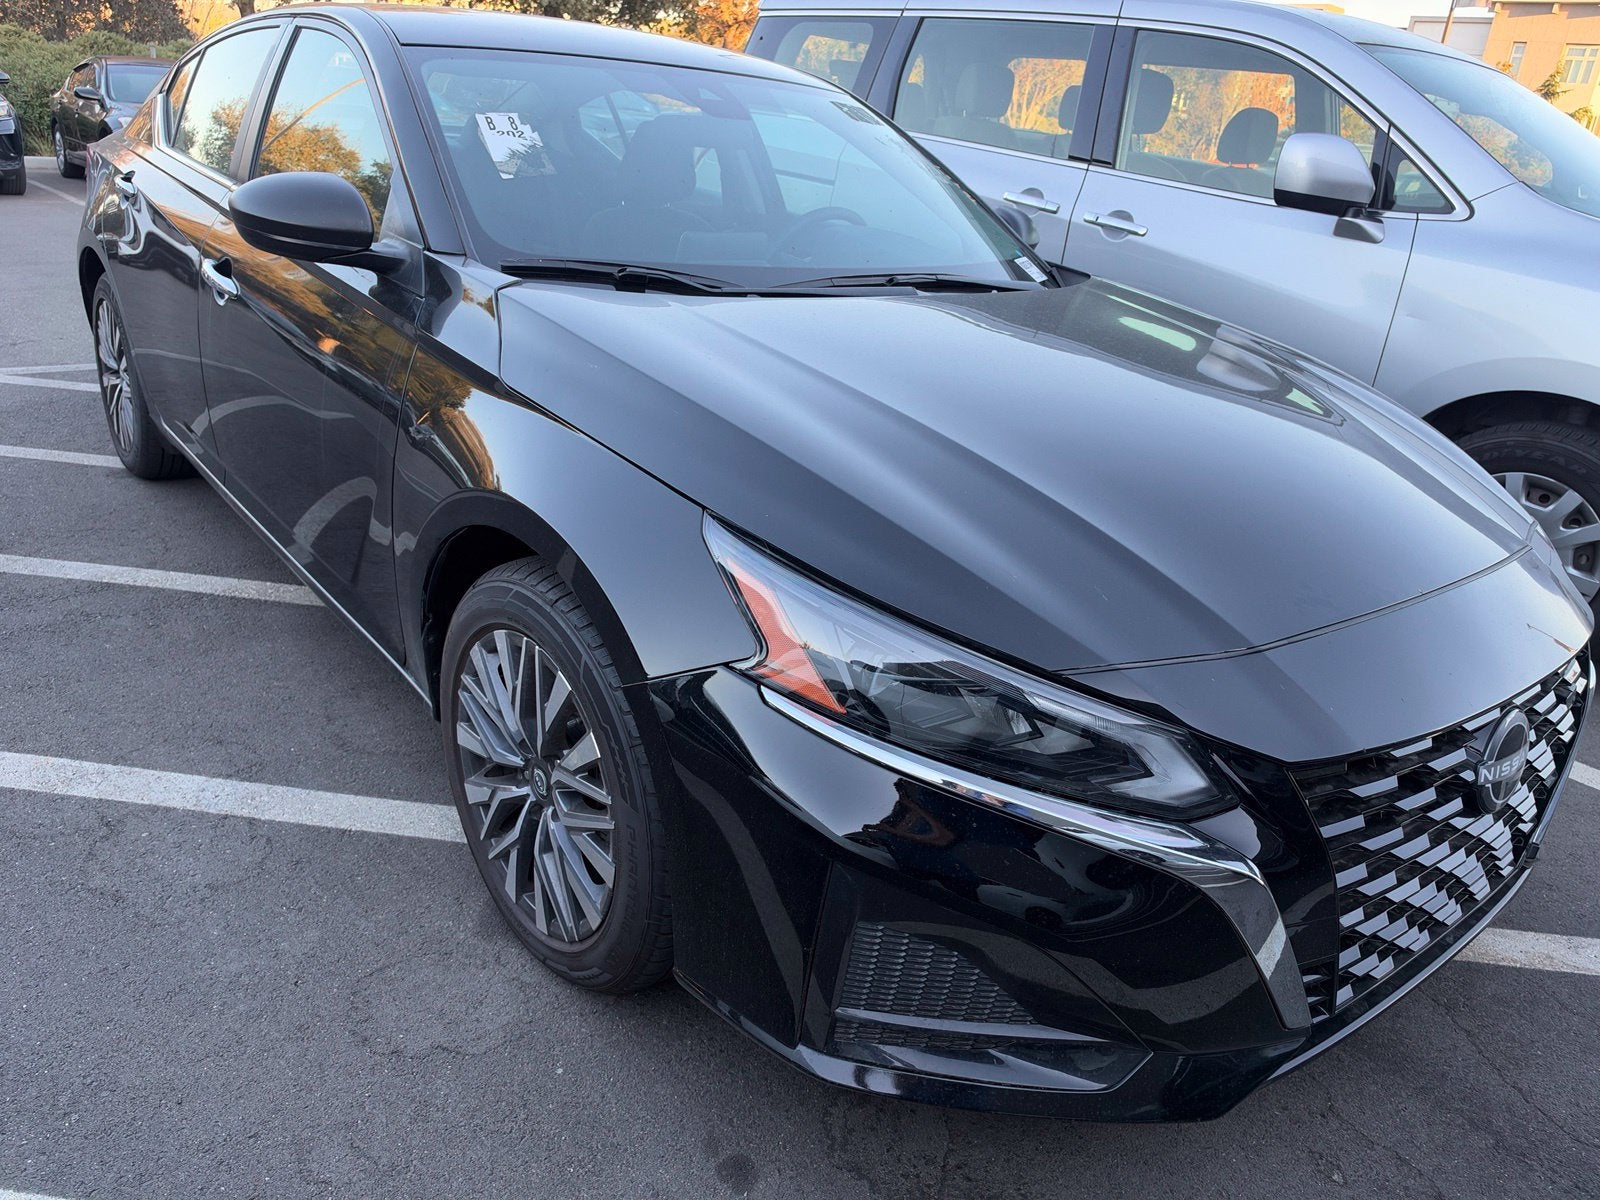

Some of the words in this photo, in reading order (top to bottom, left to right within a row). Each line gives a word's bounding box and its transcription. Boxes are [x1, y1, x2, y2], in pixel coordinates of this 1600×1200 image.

[485, 116, 496, 130] B
[508, 116, 518, 130] 8
[1480, 755, 1522, 783] NISS
